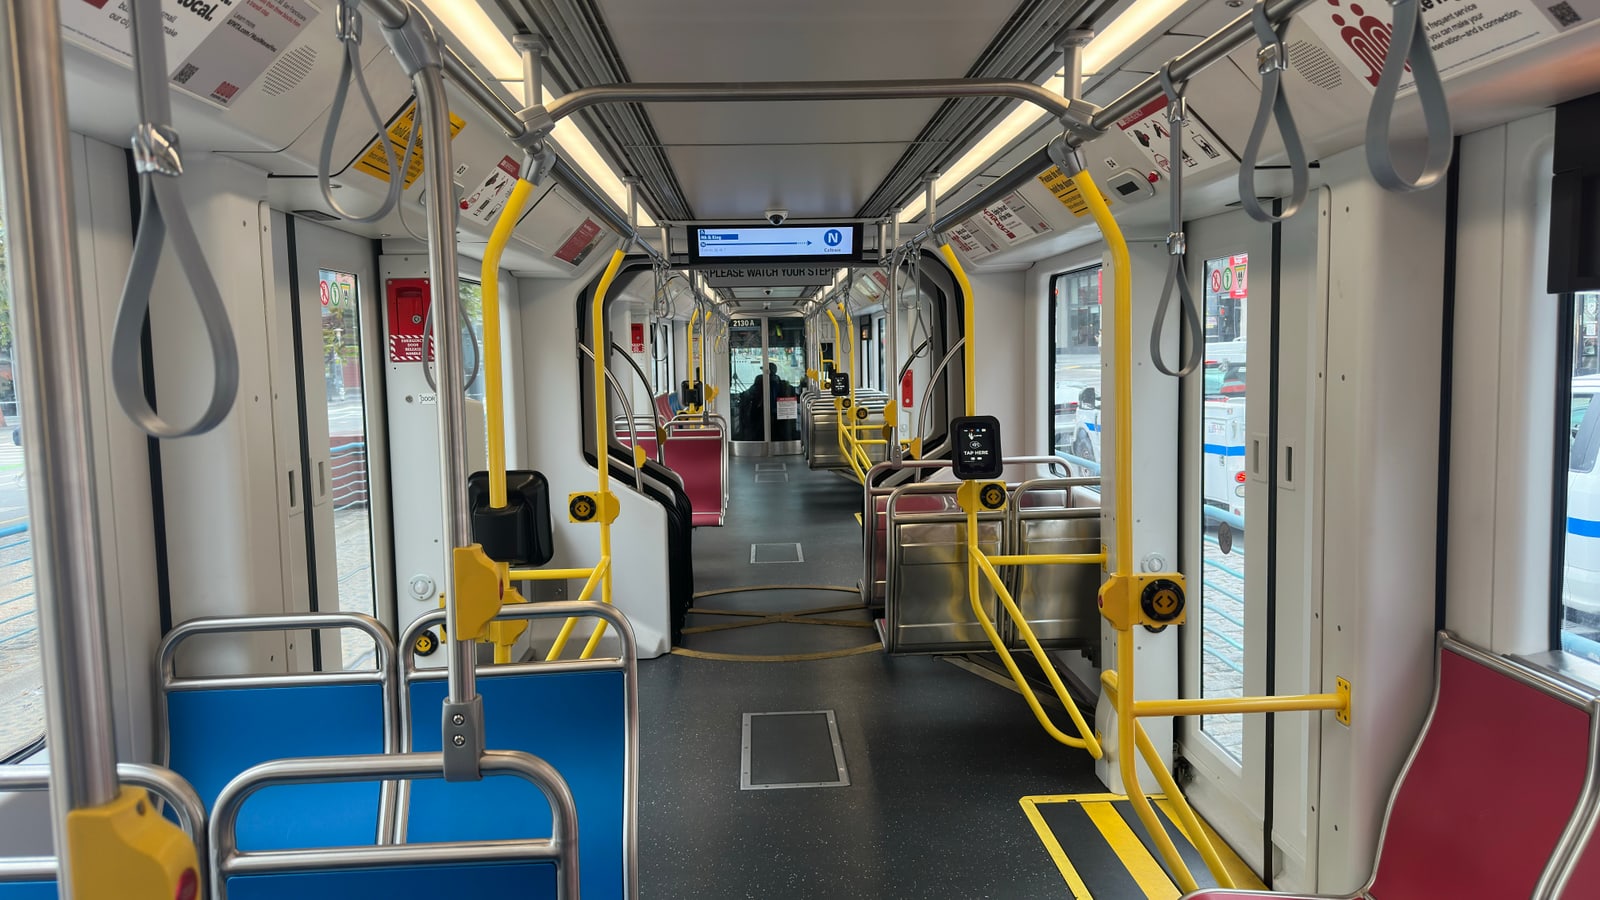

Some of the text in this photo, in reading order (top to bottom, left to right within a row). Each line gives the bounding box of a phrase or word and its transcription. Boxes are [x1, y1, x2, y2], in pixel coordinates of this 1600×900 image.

[108, 12, 122, 22] our
[177, 0, 218, 21] ocal.
[1427, 12, 1455, 31] frequent
[1454, 3, 1478, 17] service
[1483, 9, 1522, 32] connection.
[1429, 13, 1484, 42] you can make your
[828, 232, 838, 243] N
[709, 268, 831, 278] PLEASE WATCH YOUR STEP
